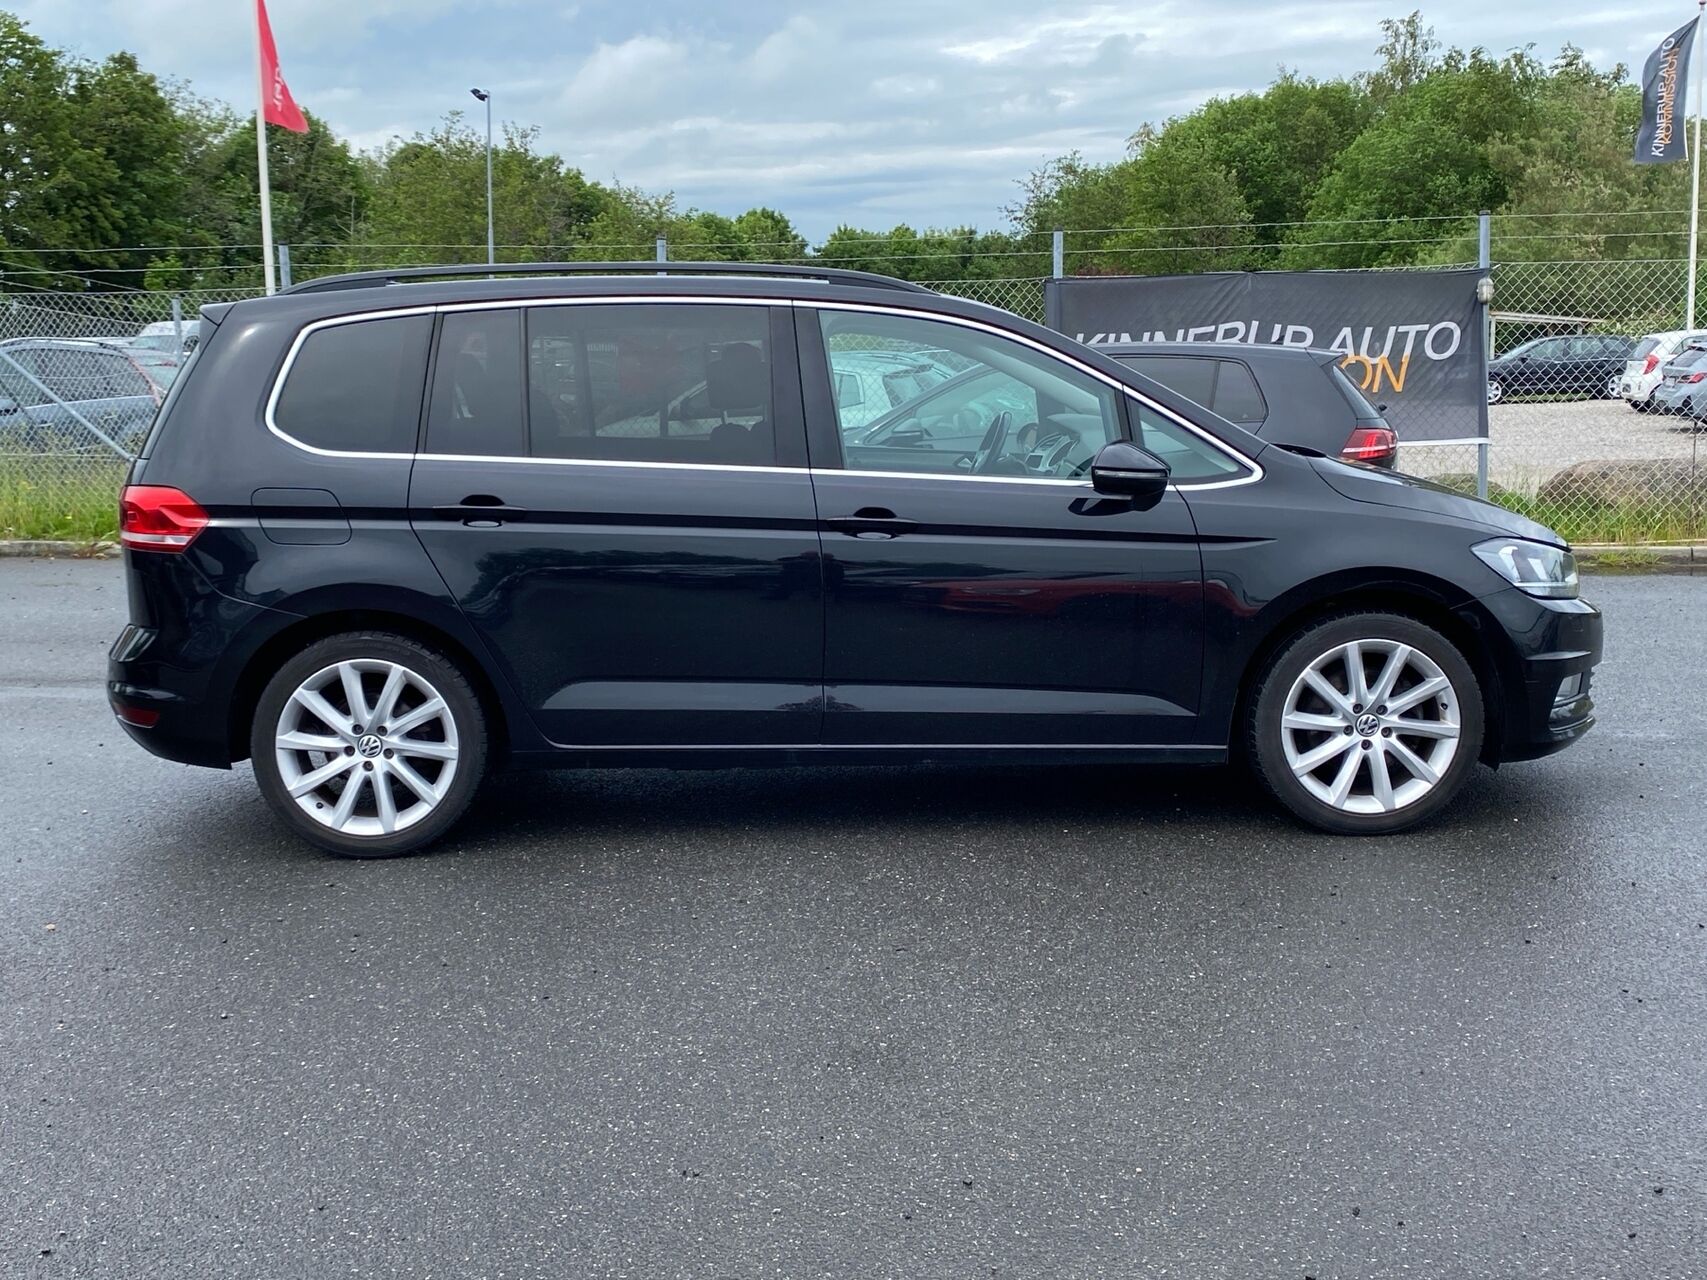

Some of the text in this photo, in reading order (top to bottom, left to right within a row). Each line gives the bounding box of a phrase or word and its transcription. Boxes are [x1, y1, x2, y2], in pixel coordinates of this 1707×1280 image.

[1329, 321, 1461, 364] AUTO
[1356, 713, 1380, 737] VW
[358, 734, 382, 758] VW
